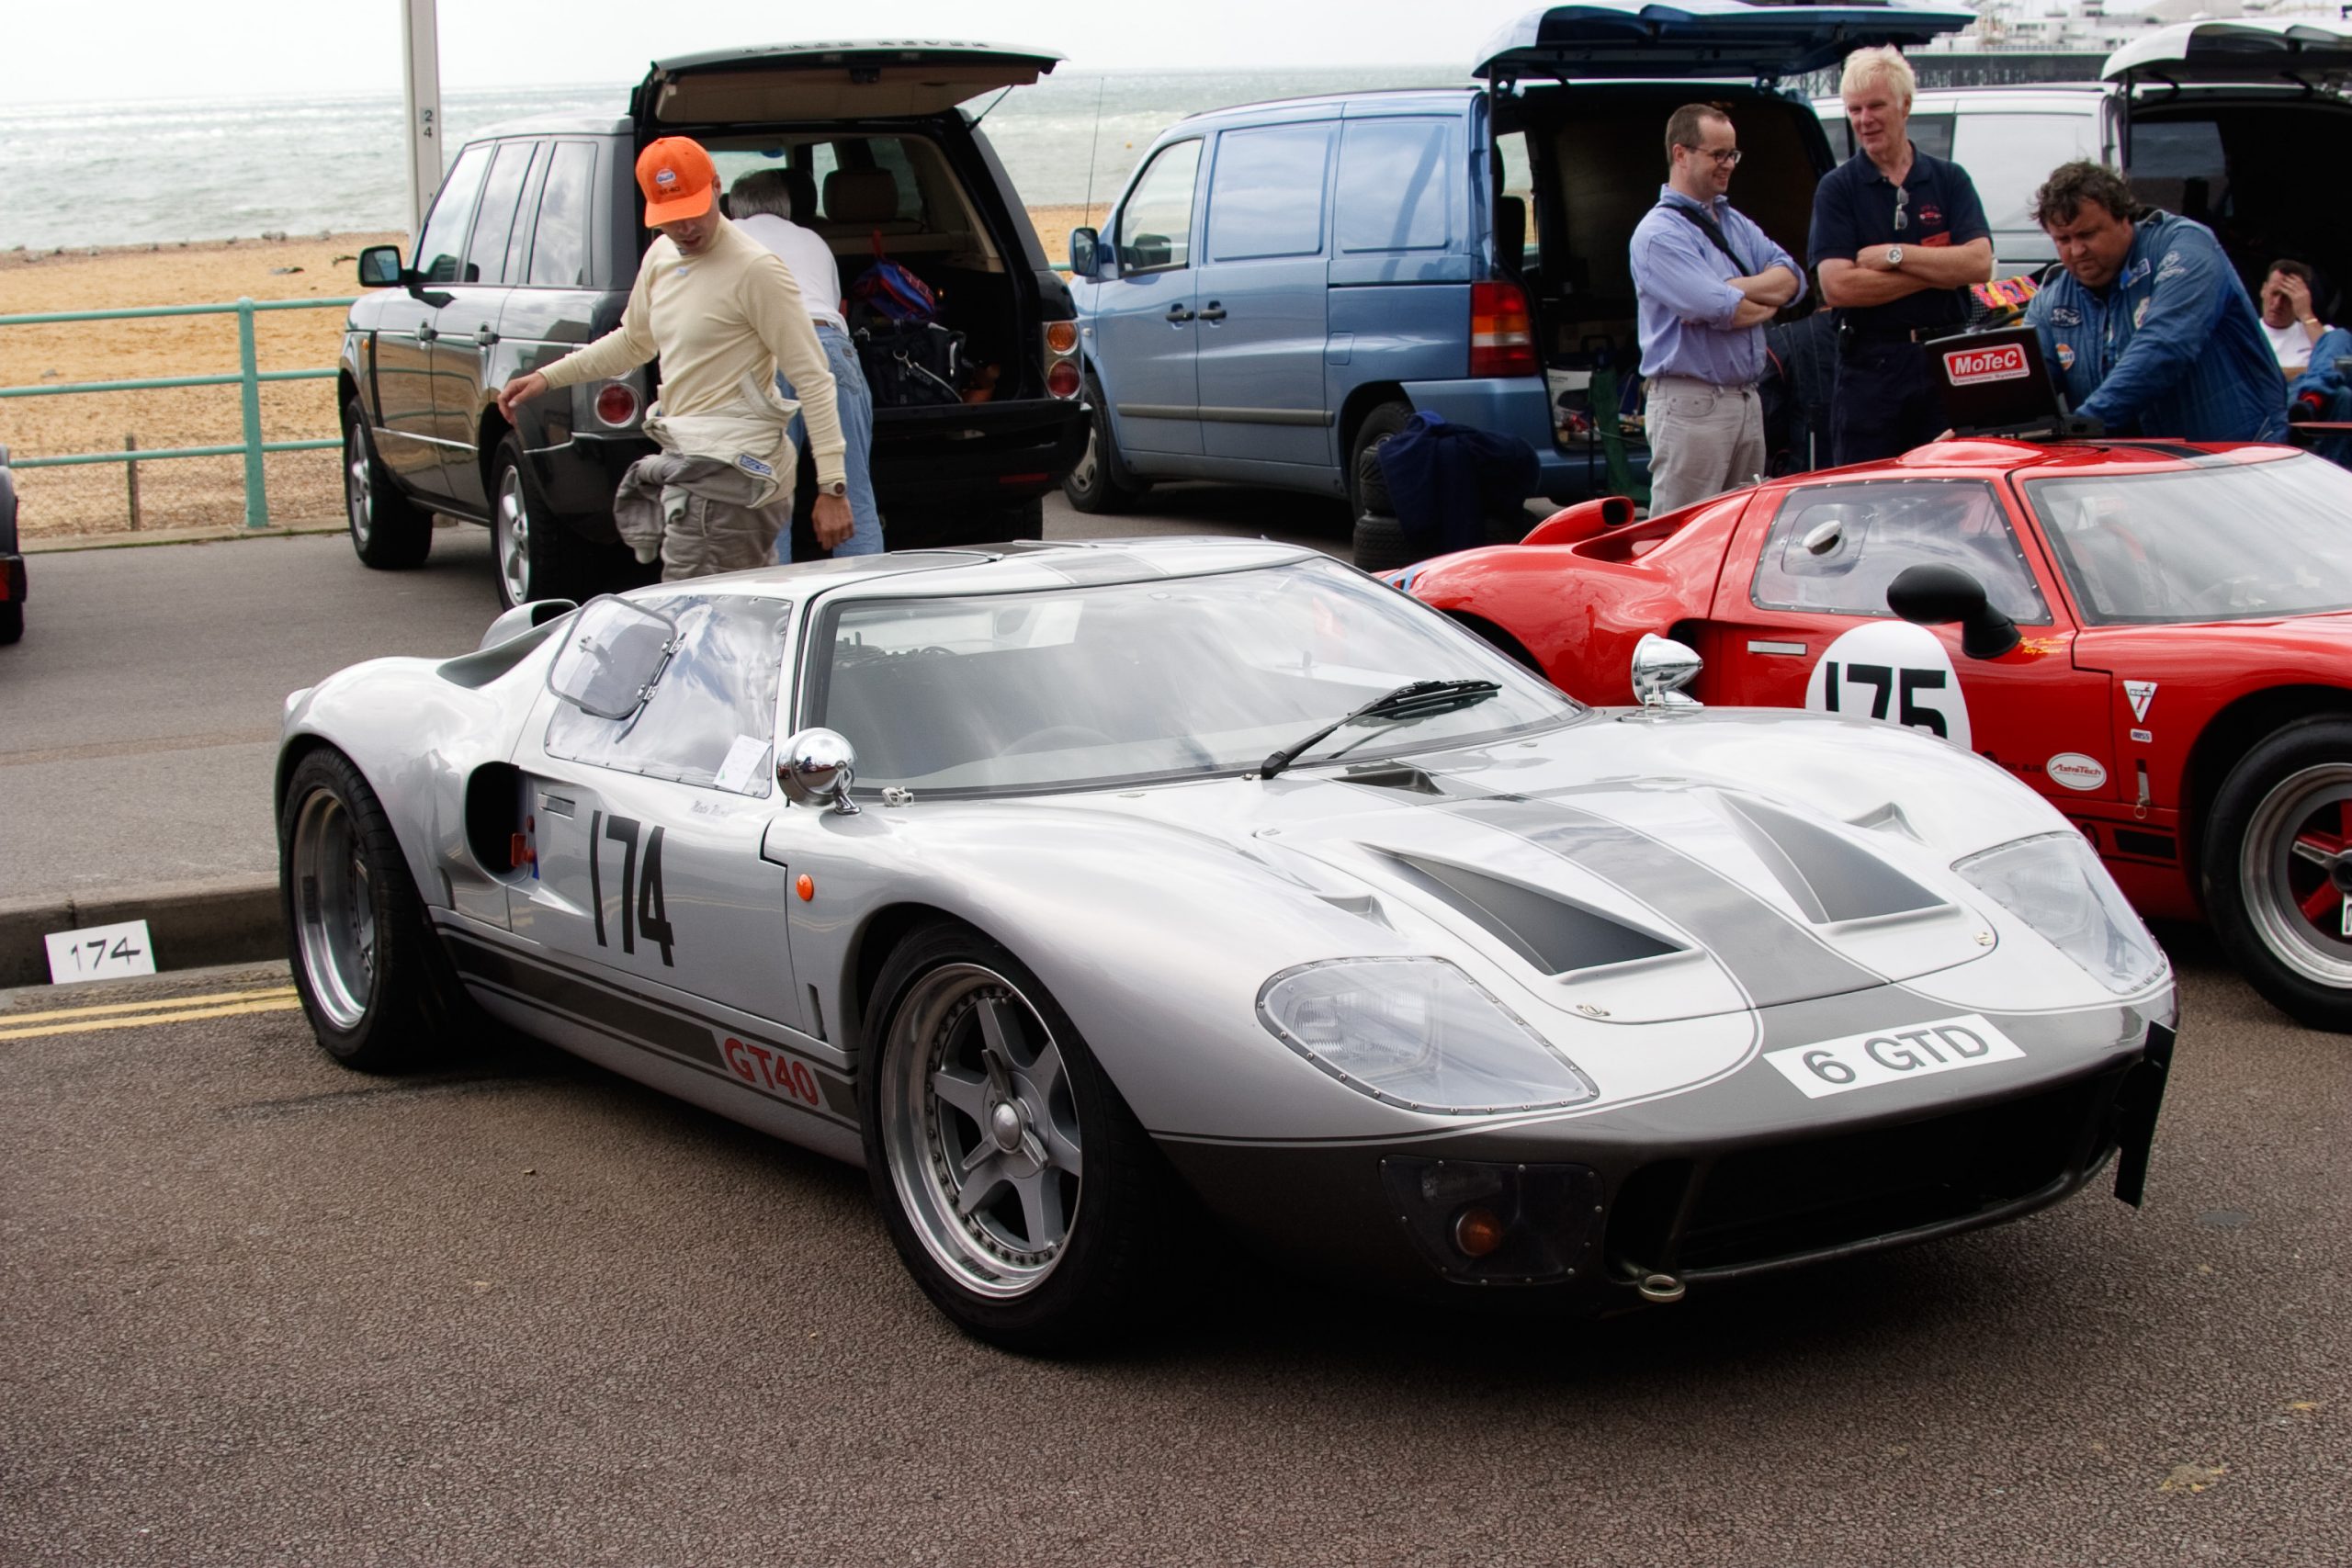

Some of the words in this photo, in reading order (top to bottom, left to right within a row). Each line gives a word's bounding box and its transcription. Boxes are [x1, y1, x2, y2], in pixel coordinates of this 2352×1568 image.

[424, 109, 433, 122] 2
[423, 126, 433, 138] 4
[2050, 308, 2082, 323] Ford
[1954, 350, 2018, 375] MoTeC
[1826, 661, 1948, 740] 175
[2052, 763, 2101, 775] AstraTech
[589, 809, 675, 967] 174
[71, 936, 141, 972] 174
[1803, 1050, 1856, 1084] 6
[1863, 1024, 1989, 1071] GTD
[724, 1037, 819, 1106] GT40
